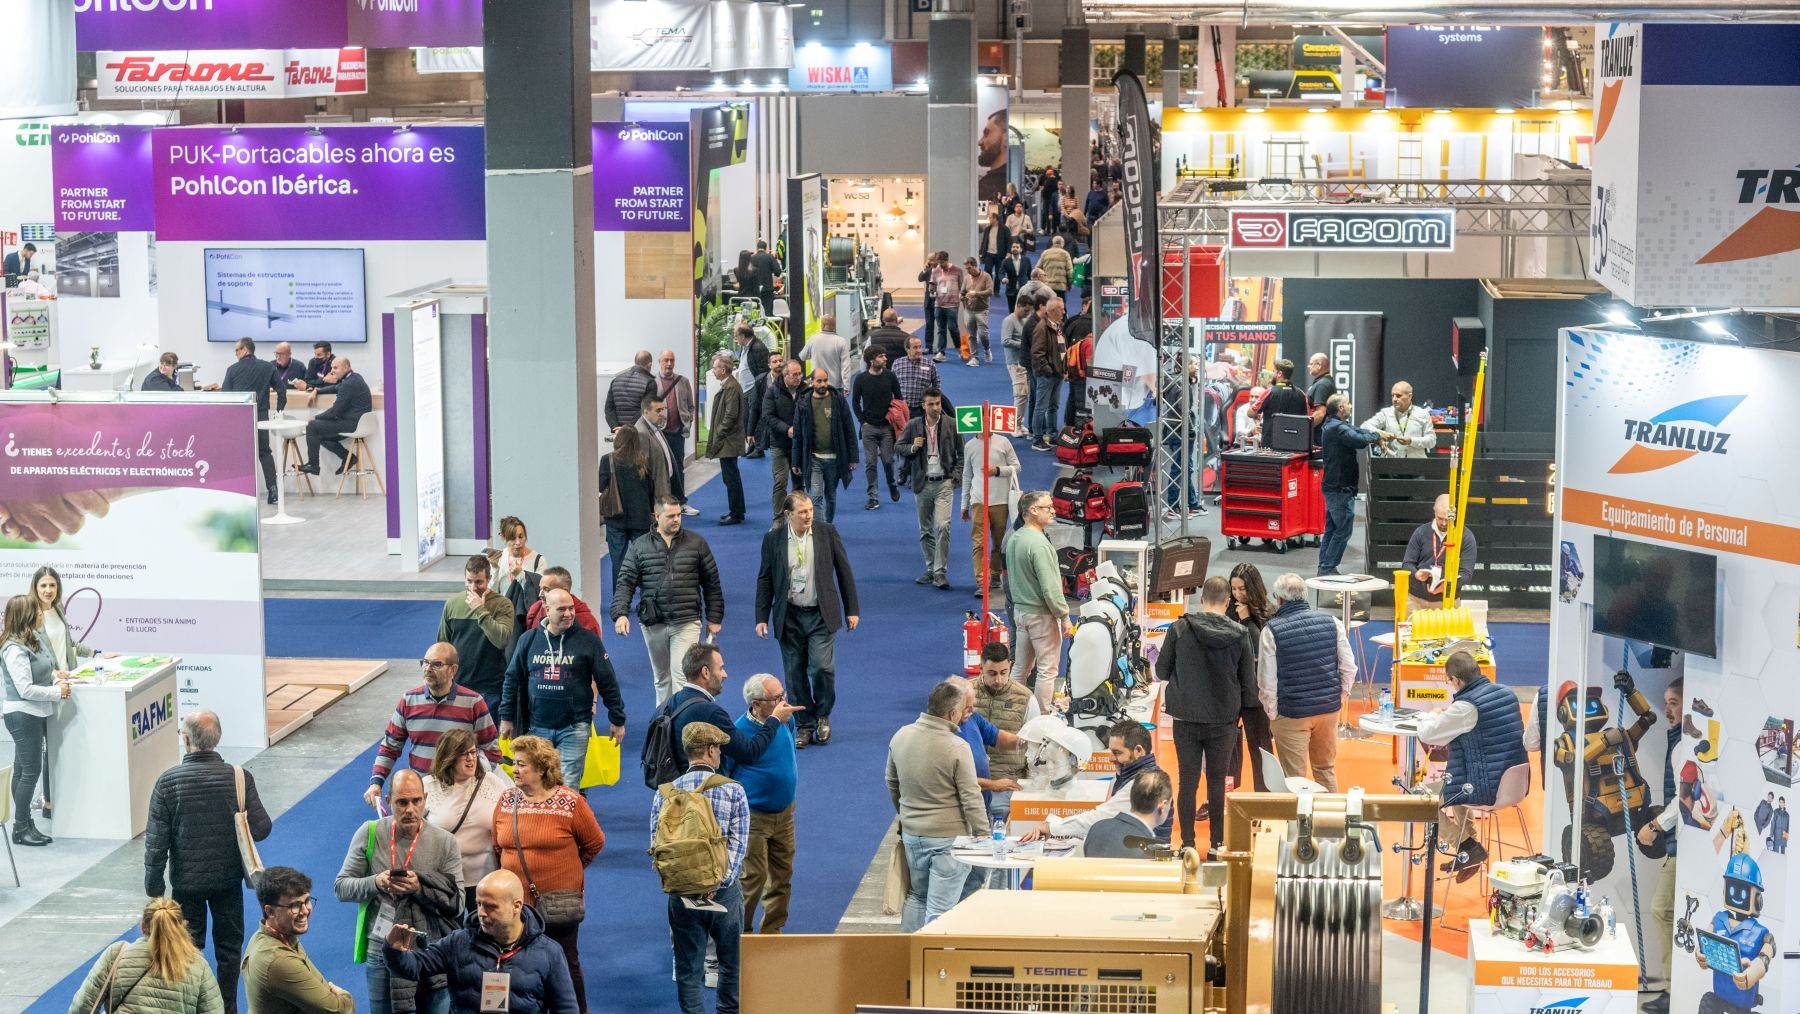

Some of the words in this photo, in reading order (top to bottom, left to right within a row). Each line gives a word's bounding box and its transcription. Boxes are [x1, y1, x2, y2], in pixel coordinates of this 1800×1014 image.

[1439, 33, 1482, 44] systems
[1601, 36, 1634, 77] TRANLUZ
[808, 67, 851, 83] WISKA
[72, 132, 120, 144] PohlCon
[632, 130, 683, 142] PohlCon
[170, 143, 356, 165] PUK-Portacables
[361, 142, 424, 163] ahora
[429, 147, 455, 163] es
[171, 175, 267, 196] PohlCon
[272, 173, 359, 195] Ibérica.
[61, 188, 108, 197] PARTNER
[633, 187, 684, 196] PARTNER
[61, 200, 92, 209] FROM
[94, 199, 126, 208] START
[615, 199, 647, 208] FROM
[649, 198, 683, 208] START
[62, 212, 77, 221] TO
[77, 212, 121, 221] FUTURE.
[621, 211, 635, 220] TO
[637, 210, 684, 220] FUTURE.
[1293, 218, 1446, 243] FACOM
[1216, 331, 1237, 341] TUS
[1239, 331, 1276, 341] MANOS
[1624, 419, 1731, 455] TRANLUZ
[56, 431, 131, 460] excedentes
[136, 431, 155, 457] de
[160, 434, 196, 460] stock
[10, 466, 22, 475] DE
[23, 467, 69, 475] APARATOS
[70, 465, 121, 476] ELÉCTRICOS
[123, 467, 128, 476] Y
[1601, 500, 1676, 537] Equipamiento
[1679, 516, 1693, 537] de
[1697, 517, 1748, 547] Personal
[533, 655, 574, 665] NORWAY
[1024, 967, 1088, 977] TESMEC
[1519, 966, 1537, 975] TODO
[1538, 967, 1552, 976] LOS
[1553, 967, 1596, 978] ACCESORIOS
[1501, 976, 1514, 985] QUE
[1517, 976, 1553, 987] NECESITAS
[1554, 978, 1572, 987] PARA
[1584, 979, 1613, 989] TRABAJO
